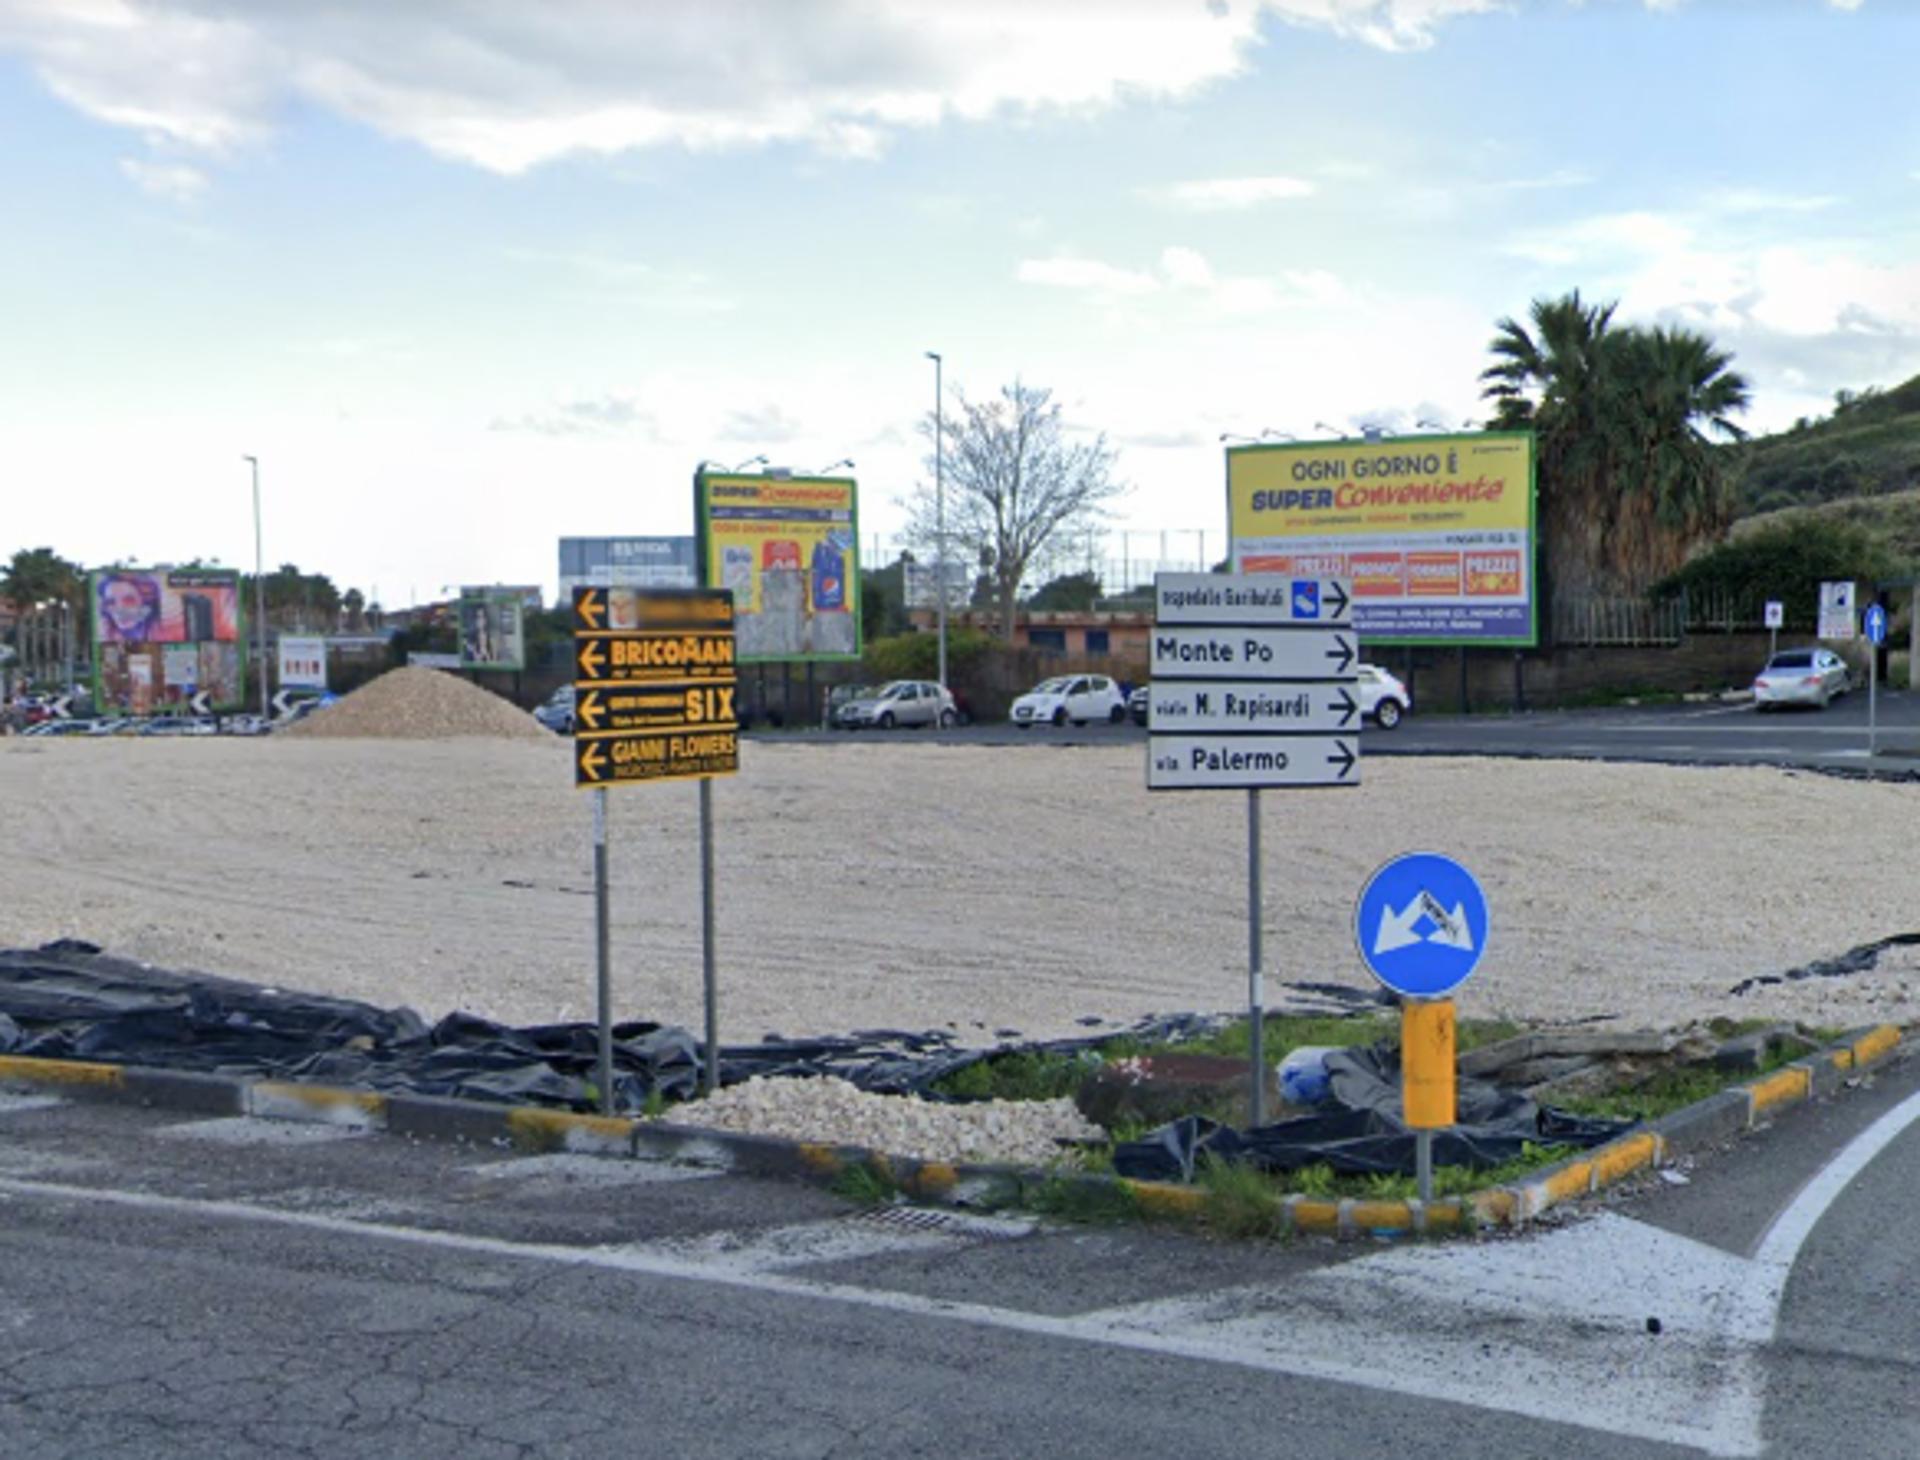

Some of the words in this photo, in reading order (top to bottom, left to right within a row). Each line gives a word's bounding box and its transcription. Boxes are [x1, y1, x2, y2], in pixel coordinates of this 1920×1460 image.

[1292, 460, 1346, 481] OGNI
[1353, 453, 1440, 478] GIORNO
[1225, 587, 1284, 606] Garibaldi
[1156, 638, 1233, 661] Monte
[1244, 640, 1273, 661] Po
[685, 687, 734, 721] SIX
[1156, 700, 1188, 715] viale
[1225, 692, 1310, 720] Rapisardi
[611, 738, 666, 763] GIANNI
[669, 733, 735, 757] FLOWERS
[1156, 757, 1179, 770] via
[1192, 747, 1289, 771] Palermo
